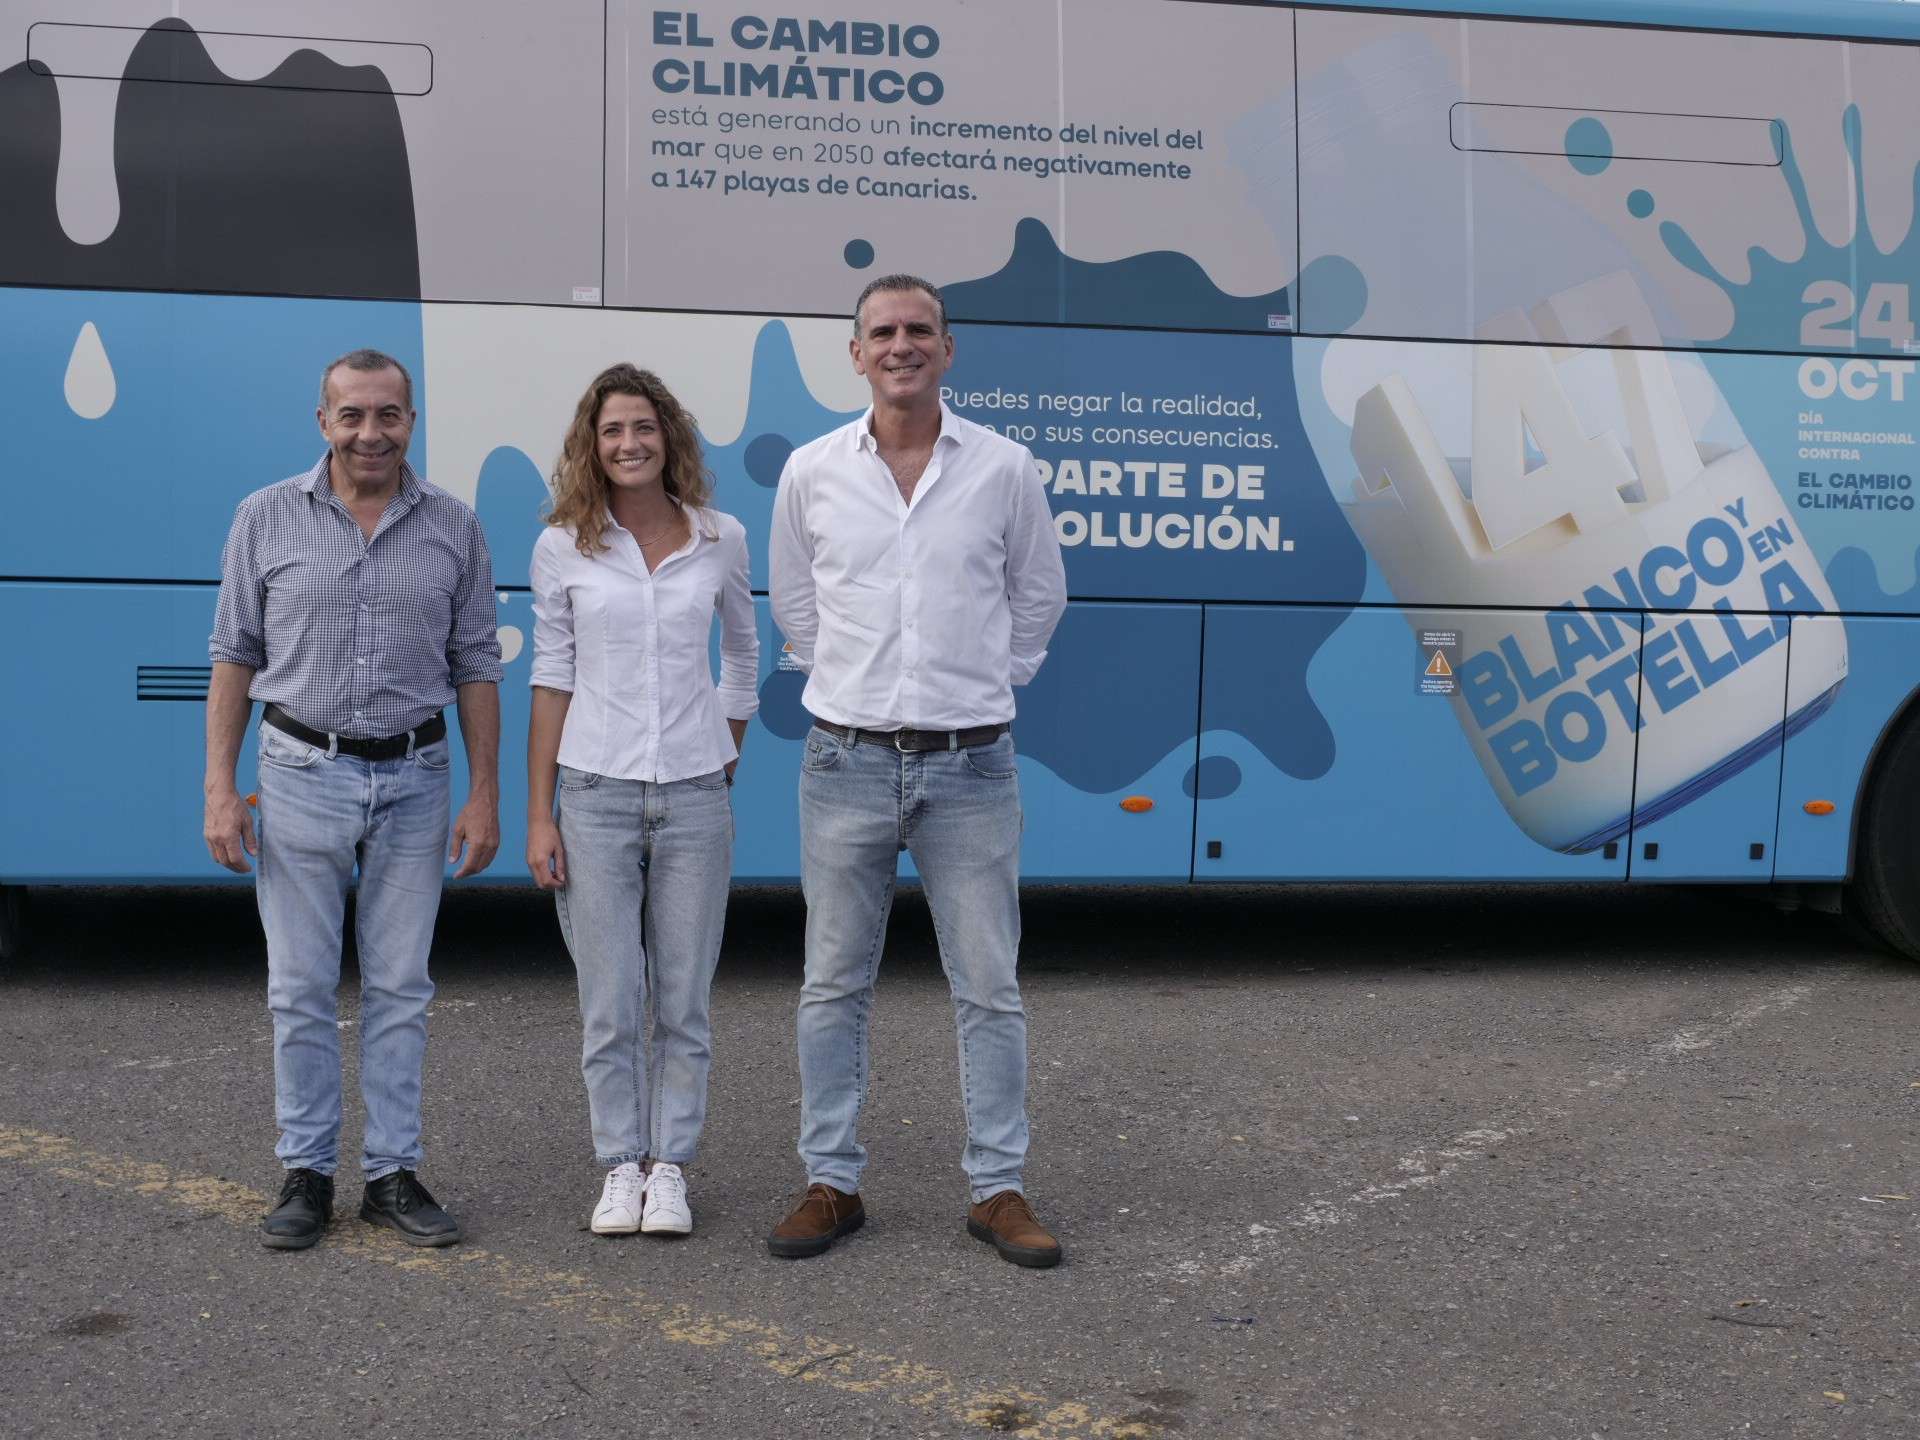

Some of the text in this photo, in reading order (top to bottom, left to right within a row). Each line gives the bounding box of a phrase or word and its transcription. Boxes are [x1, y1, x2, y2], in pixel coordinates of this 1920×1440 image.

[652, 11, 940, 59] EL CAMBIO
[652, 56, 945, 105] CLIMÁTICO
[651, 104, 1204, 150] está generando un incremento del nivel del
[651, 140, 1193, 180] mar que en 2050 afectará negativamente
[651, 167, 978, 201] a 147 playas de Canarias.
[1800, 279, 1915, 350] 24
[1798, 357, 1916, 401] OCT
[940, 386, 1263, 421] Puedes negar la realidad,
[1350, 269, 1706, 560] 147
[1798, 410, 1824, 425] DÍA
[1006, 424, 1036, 441] no
[1045, 426, 1084, 444] sus
[1091, 427, 1280, 449] consecuencias.
[1798, 430, 1916, 445] INTERNACIONAL
[1798, 447, 1861, 461] CONTRA
[1201, 463, 1265, 500] DE
[1797, 471, 1913, 491] EL CAMBIO
[1797, 489, 1916, 511] CLIMÁTICO
[1054, 505, 1295, 552] OLUCIÓN.
[1460, 496, 1795, 731] BLANCO Y EN
[1487, 559, 1825, 798] BOTELLA
